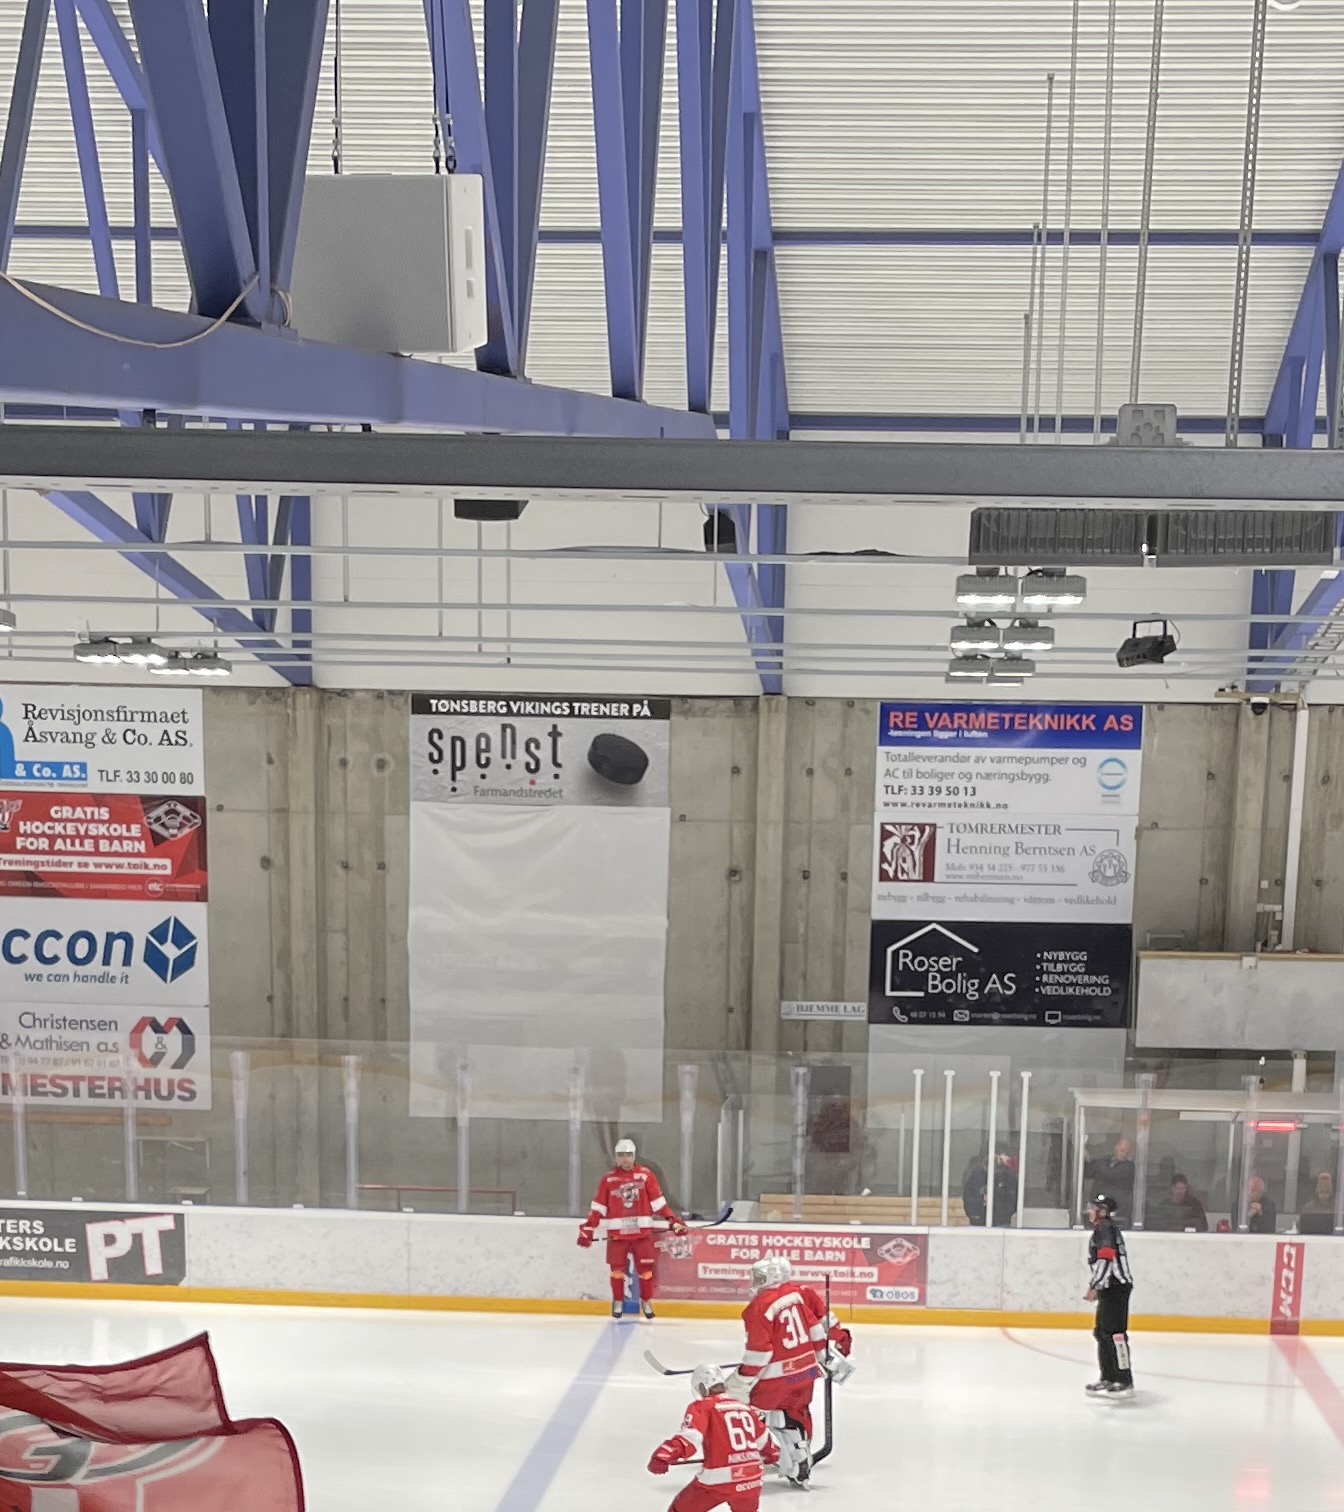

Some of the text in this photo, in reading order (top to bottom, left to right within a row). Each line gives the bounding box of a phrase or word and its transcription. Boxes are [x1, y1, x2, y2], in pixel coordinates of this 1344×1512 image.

[22, 703, 189, 725] Revisjonsfirmaet
[430, 699, 652, 717] TØNSBERG VIKINGS TRENER PÅ
[889, 711, 1135, 732] RE VARMETEKNIKK AS
[23, 719, 193, 749] Åsvang & Co. AS.
[884, 751, 1087, 768] Totalleverandør varmepumper og
[126, 770, 177, 785] 33 30 00
[884, 768, 1052, 784] AC boliger næringsbygg.
[473, 785, 564, 799] Farmandstredet
[910, 785, 977, 797] 33 39 50 13
[50, 806, 110, 820] GRATIS
[19, 821, 141, 837] HOCKEYSKOLE
[16, 837, 146, 853] FOR ALLE BARN
[946, 837, 1010, 857] Henning
[899, 950, 963, 972] Roser
[1043, 951, 1088, 962] NYBYGG
[1041, 963, 1086, 973] TILBYGG
[24, 970, 118, 984] we can handle
[1041, 974, 1110, 985] RENOVERING
[927, 973, 1017, 1000] Bolig AS
[1040, 986, 1112, 996] VEDLIKEHOLD
[18, 1011, 118, 1031] Christensen
[15, 1034, 89, 1053] Mathisen
[1, 1072, 197, 1102] MESTERHUS
[85, 1213, 177, 1282] PT
[706, 1234, 871, 1249] GRATIS HOCKEYSKOLE
[730, 1248, 846, 1262] FOR BARN
[1279, 1244, 1296, 1317] CCM
[886, 1290, 916, 1300] OBOS
[779, 1306, 809, 1349] 31
[724, 1411, 758, 1451] 69
